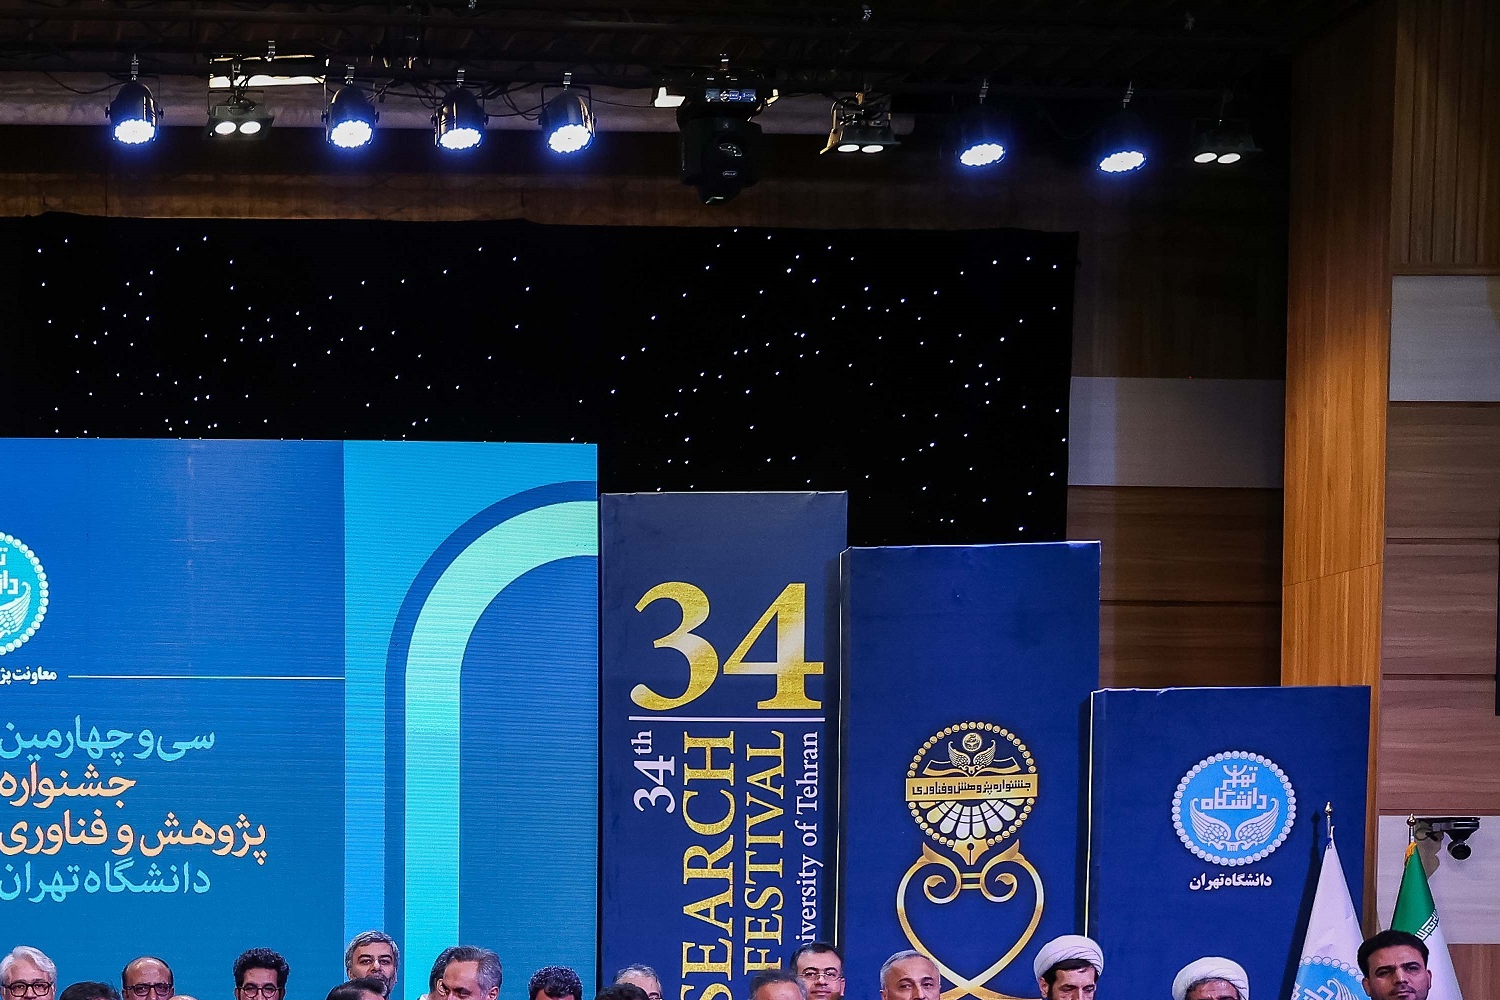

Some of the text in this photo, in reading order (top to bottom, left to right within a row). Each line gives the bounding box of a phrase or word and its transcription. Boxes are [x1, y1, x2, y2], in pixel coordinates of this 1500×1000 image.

[630, 581, 825, 711] 34
[12, 666, 57, 685] معاونت
[133, 728, 155, 760] و
[156, 731, 215, 762] سی
[630, 730, 676, 814] 34th
[912, 781, 946, 795] فناوری
[994, 779, 1031, 793] جشنواره
[954, 781, 993, 796] پژوهش
[1201, 787, 1268, 809] دانشگاه
[111, 823, 134, 856] و
[139, 811, 268, 866] پژوهش
[743, 730, 786, 976] FESTIVAL
[794, 731, 825, 946] iversity of Tehran
[83, 857, 212, 894] دانشگاه
[1189, 872, 1273, 891] دانشگاه تهران
